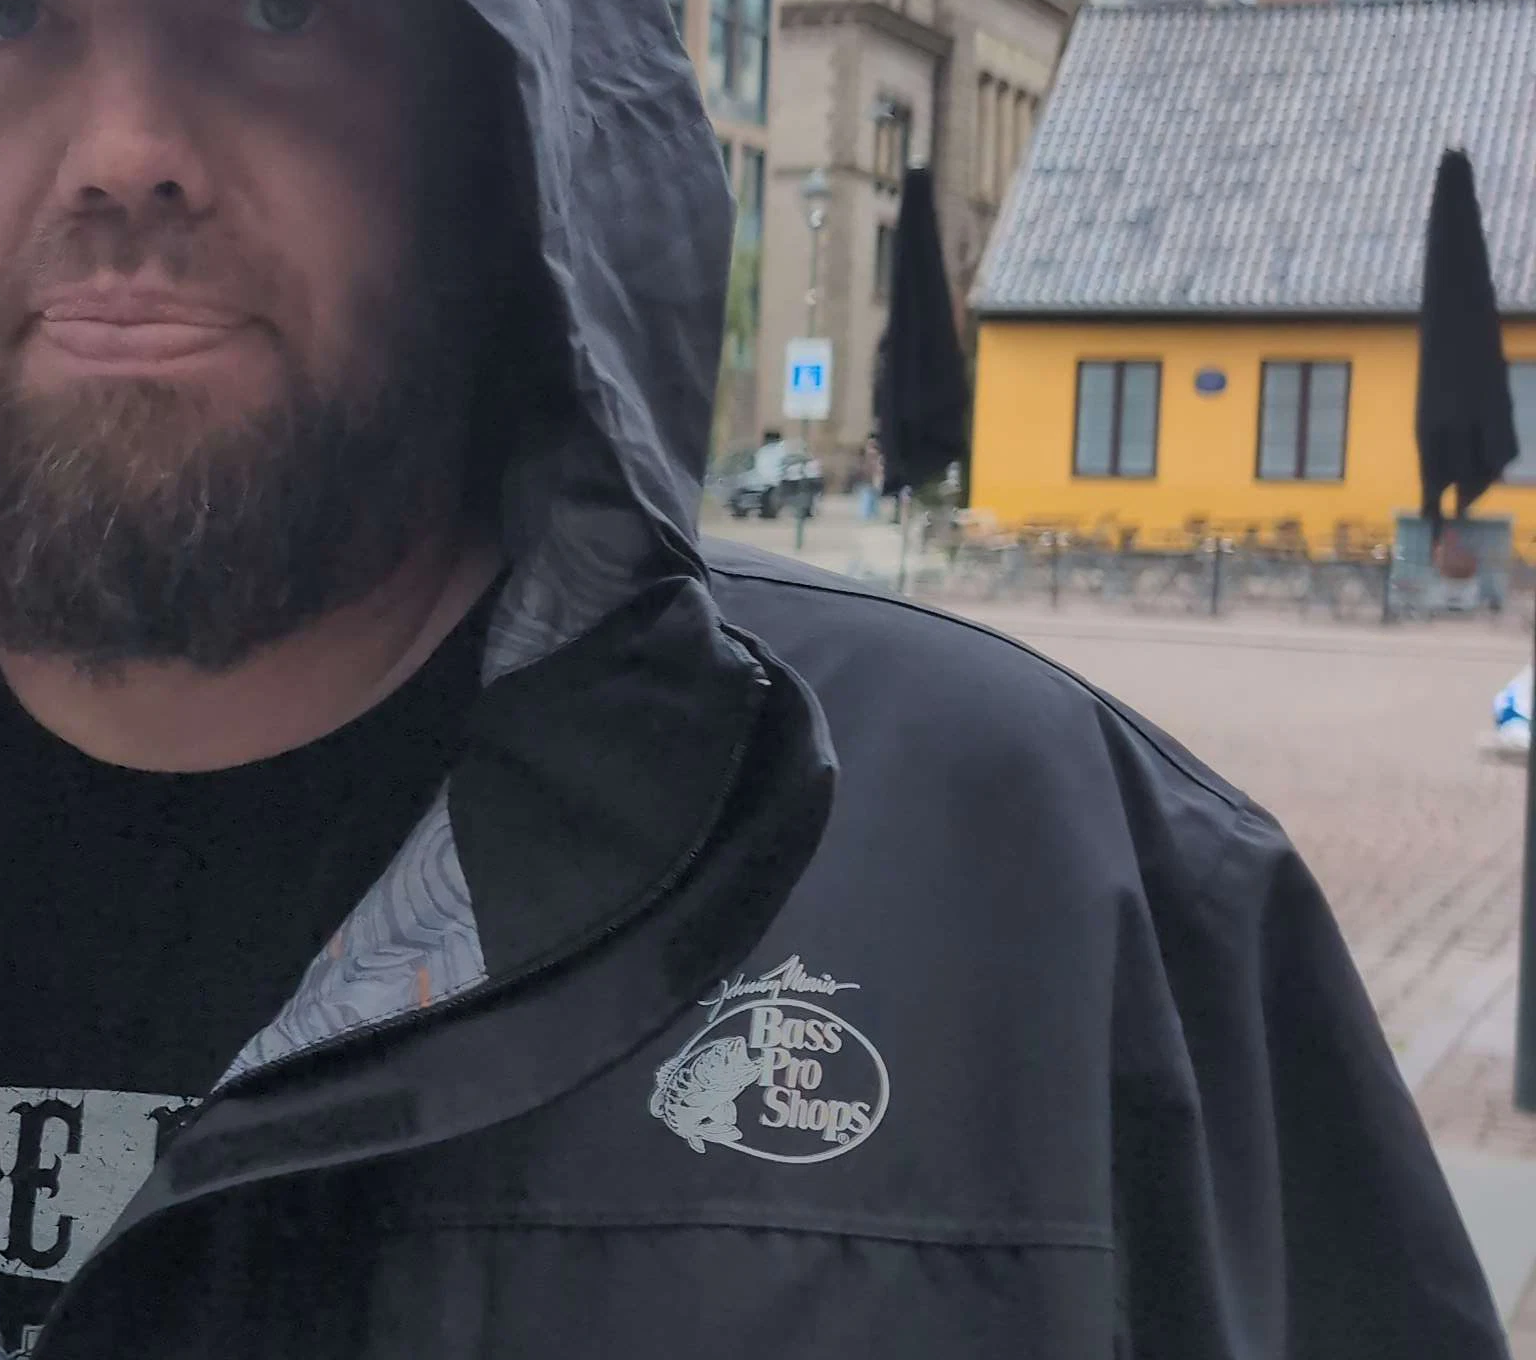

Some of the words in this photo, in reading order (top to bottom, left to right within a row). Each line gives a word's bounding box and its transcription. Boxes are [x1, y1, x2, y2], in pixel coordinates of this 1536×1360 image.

[749, 1006, 843, 1054] Bass
[758, 1048, 823, 1090] Pro
[759, 1087, 871, 1141] Shops
